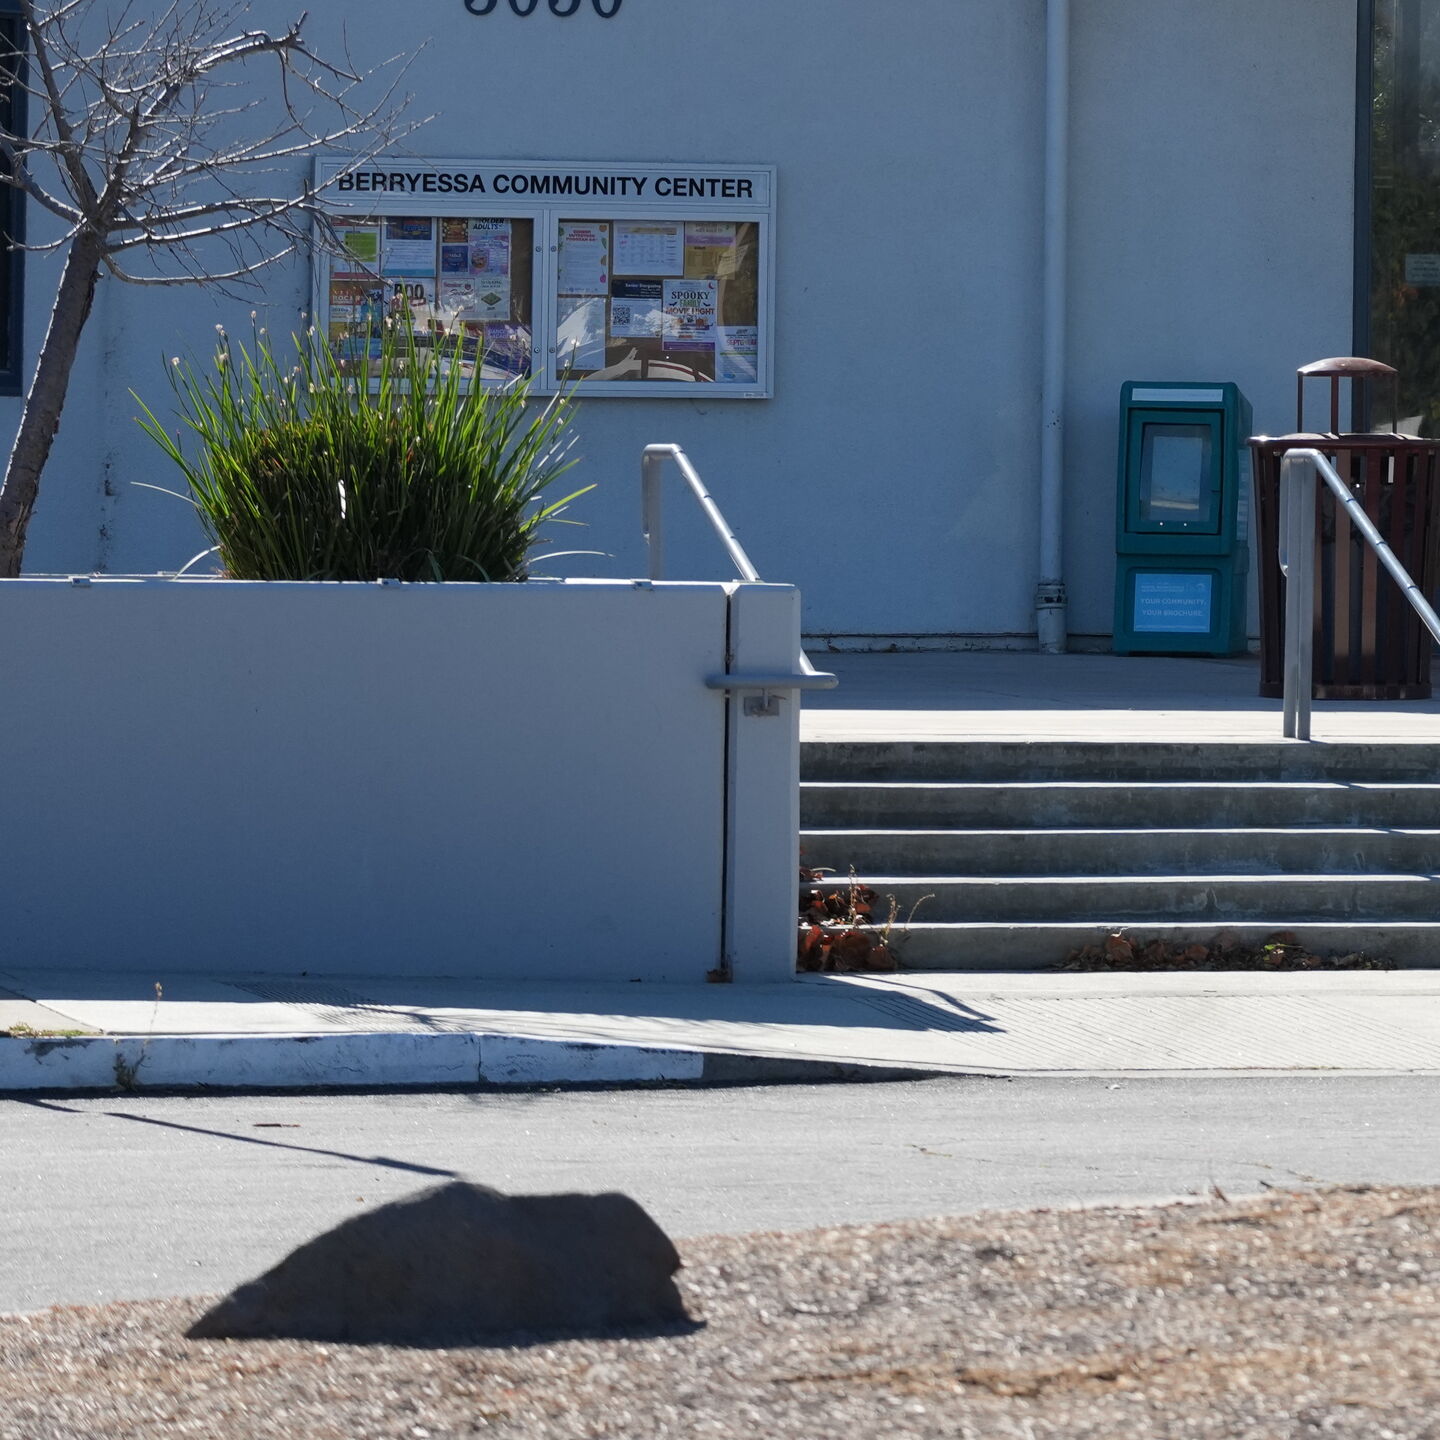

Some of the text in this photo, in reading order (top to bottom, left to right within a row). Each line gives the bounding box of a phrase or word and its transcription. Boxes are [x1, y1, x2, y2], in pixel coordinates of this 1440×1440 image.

[338, 172, 753, 197] BERRYESSA COMMUNITY CENTER
[671, 291, 710, 300] SPOOKY
